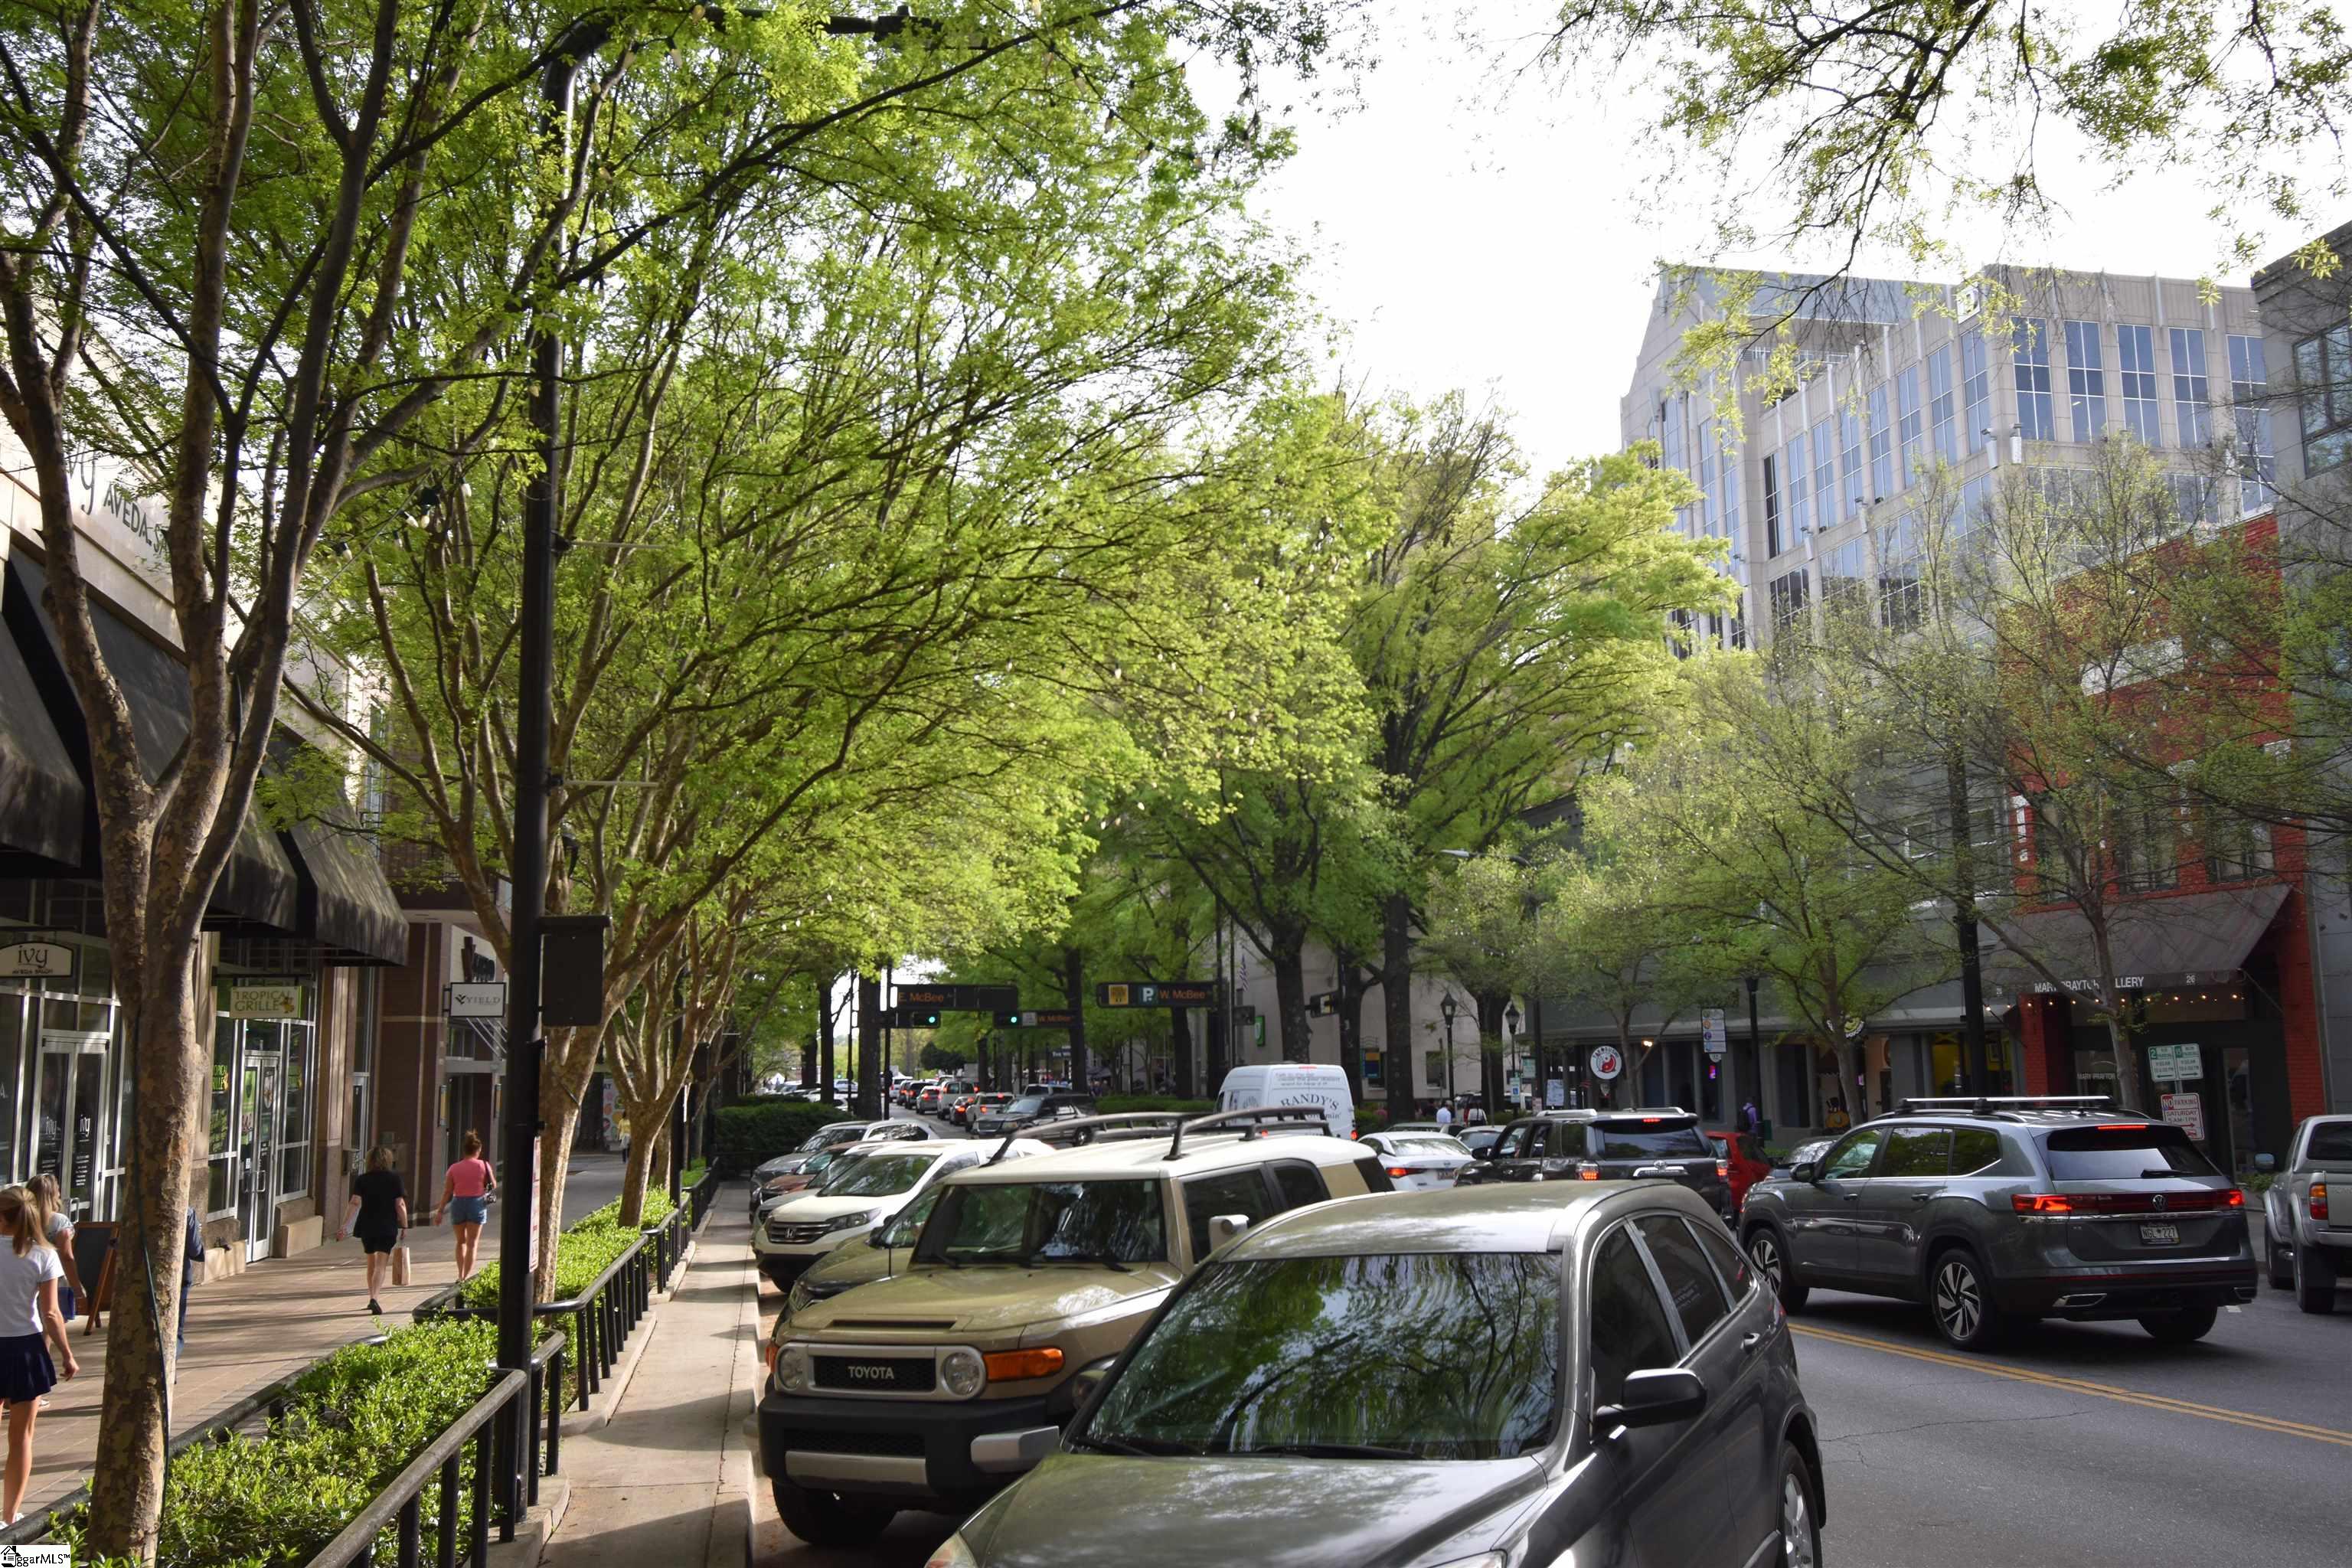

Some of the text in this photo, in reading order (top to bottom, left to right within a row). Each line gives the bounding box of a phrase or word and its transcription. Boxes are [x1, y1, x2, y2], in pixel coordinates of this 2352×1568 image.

[103, 481, 152, 547] AVEDA
[18, 945, 50, 969] ivy
[2115, 976, 2145, 988] LLERY
[2186, 973, 2196, 984] 26
[233, 990, 292, 1001] TROPICAL
[910, 992, 944, 1002] McBee
[1172, 989, 1207, 999] McBee
[234, 1000, 283, 1011] GRILLE
[466, 996, 501, 1004] YIELD
[2150, 1048, 2158, 1060] 2
[1280, 1093, 1340, 1111] RANDY'S
[2162, 1099, 2174, 1108] NO
[2162, 1227, 2175, 1238] 227
[848, 1365, 895, 1380] TOYOTA
